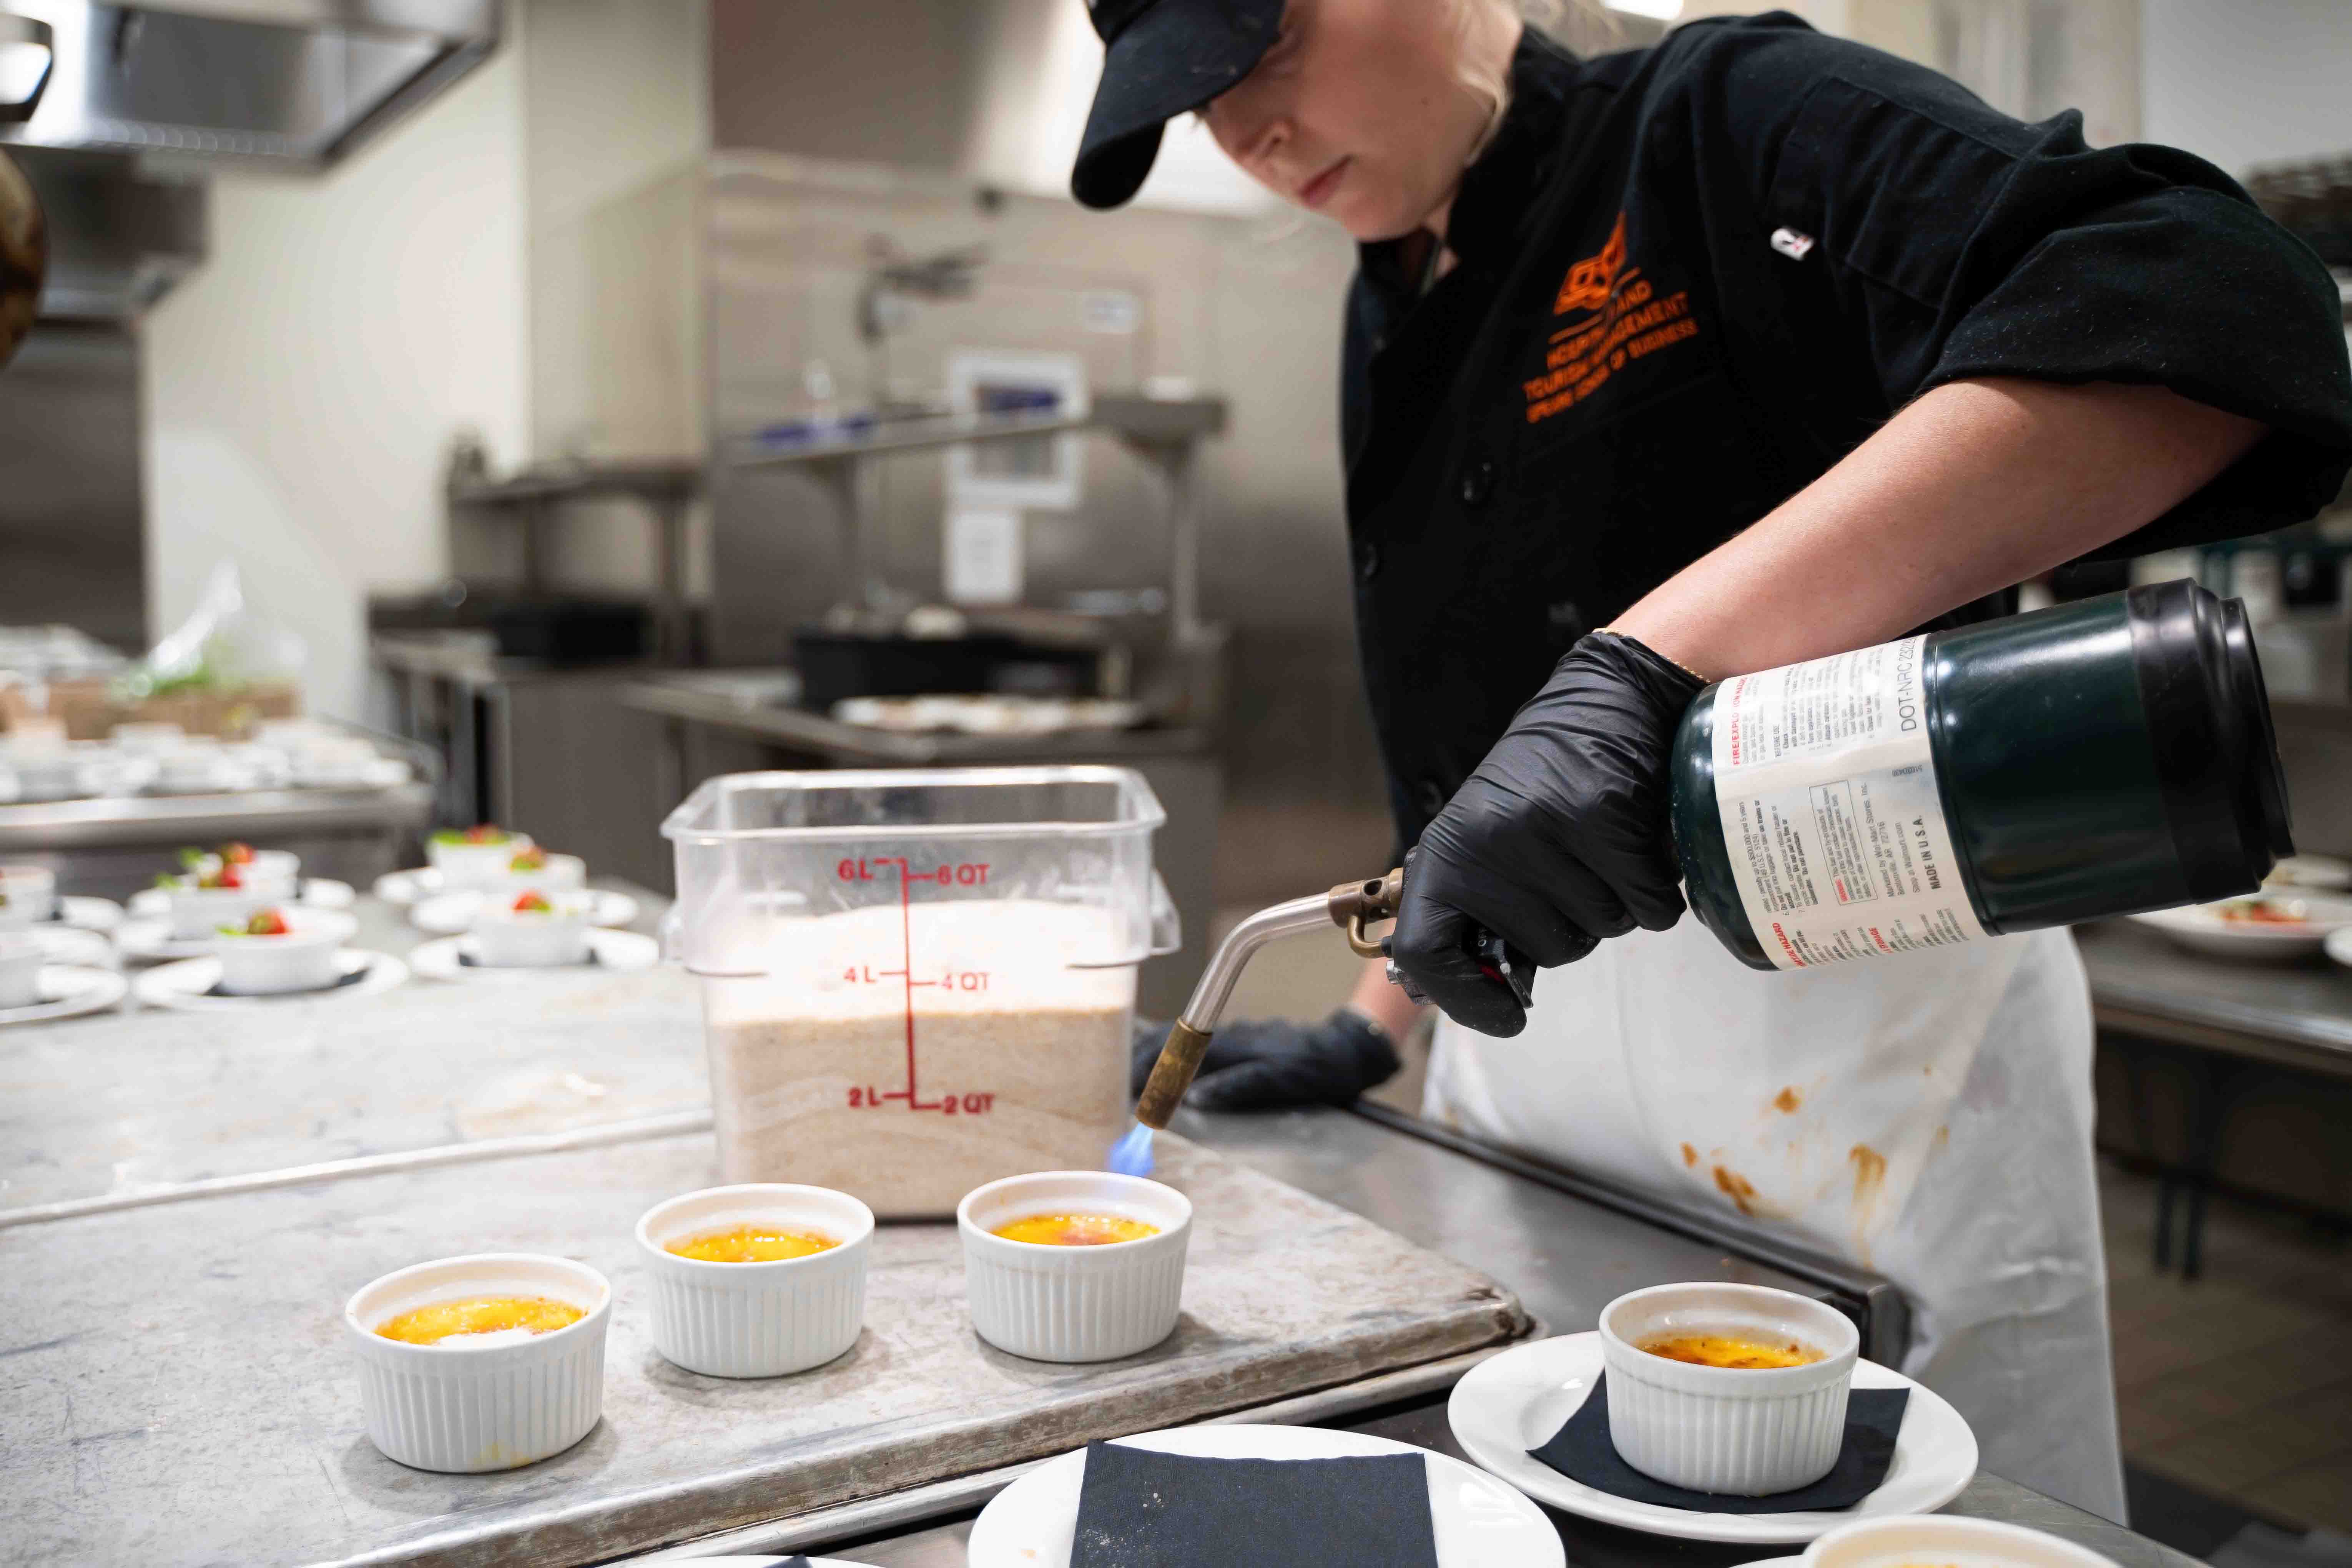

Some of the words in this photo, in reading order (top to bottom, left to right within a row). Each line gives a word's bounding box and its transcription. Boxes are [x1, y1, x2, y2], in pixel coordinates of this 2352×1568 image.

[1897, 662, 1917, 732] DOT-NRC
[1731, 695, 1741, 765] FIRE/EXPLOION
[1912, 815, 1928, 848] U.S.A.
[1884, 848, 1893, 858] AR
[1920, 850, 1932, 861] IN
[838, 859, 856, 881] 6
[858, 858, 874, 880] L
[956, 864, 990, 885] QT
[1924, 863, 1941, 890] MADE
[1772, 923, 1791, 949] HAZARD
[843, 966, 857, 983] 4
[864, 966, 877, 983] L
[941, 974, 953, 990] 4
[960, 972, 991, 991] QT
[848, 1087, 863, 1107] 2
[868, 1086, 882, 1107] L
[942, 1095, 958, 1115] 2
[963, 1092, 995, 1114] QT
